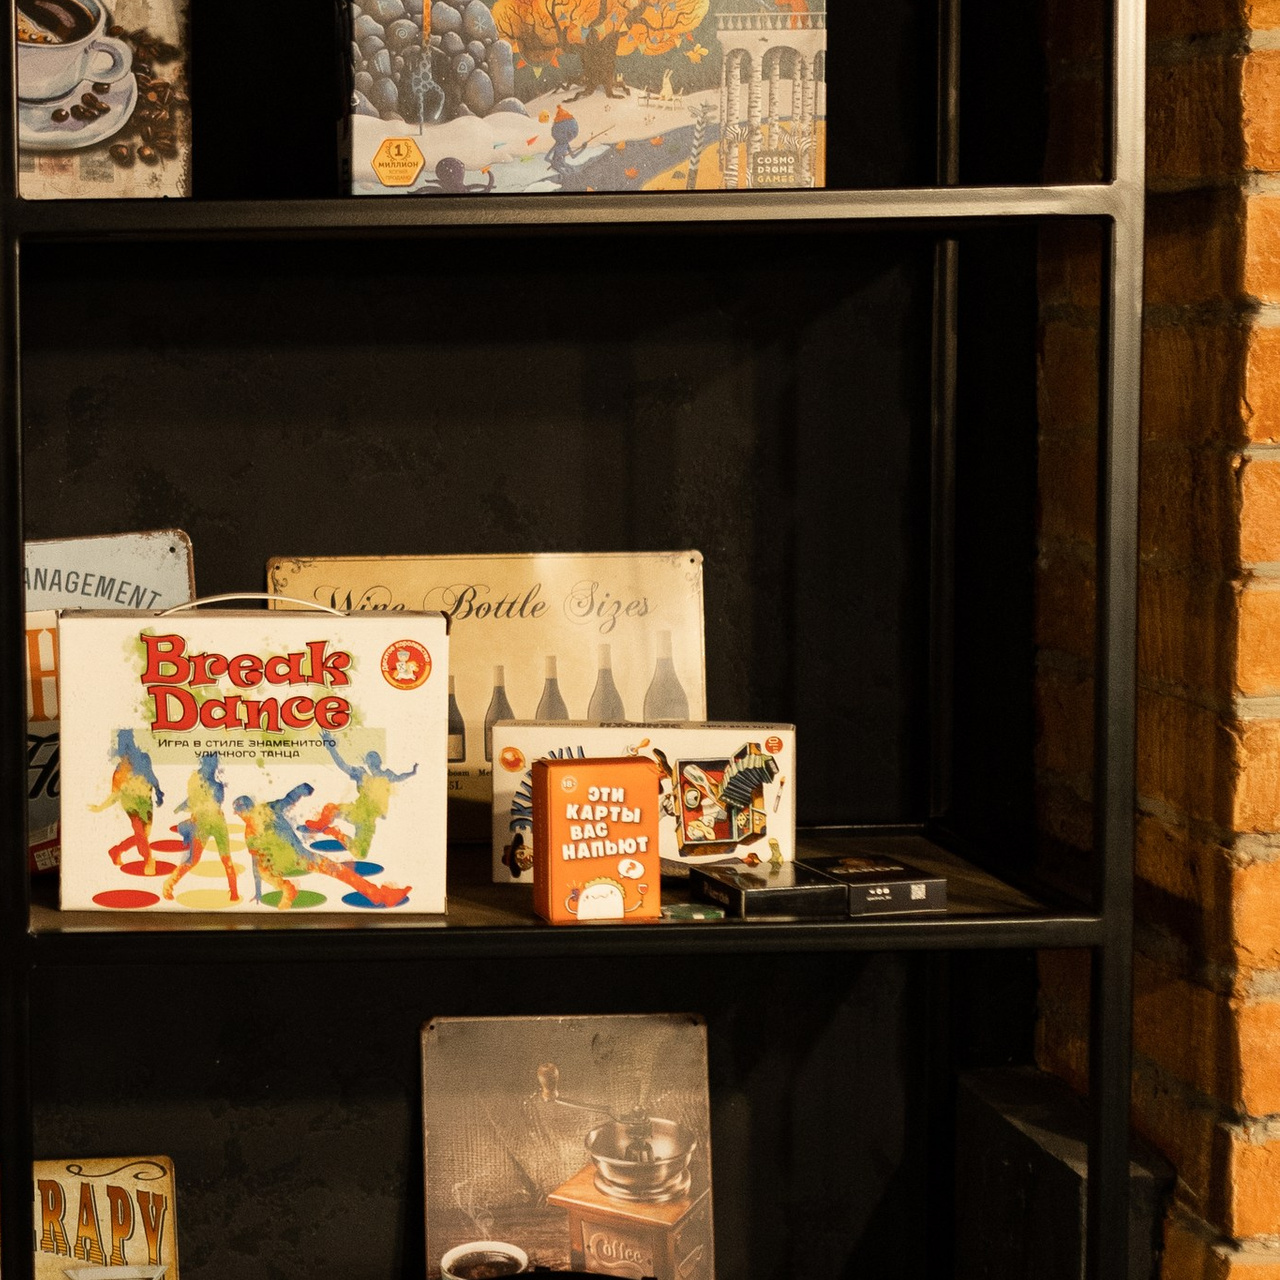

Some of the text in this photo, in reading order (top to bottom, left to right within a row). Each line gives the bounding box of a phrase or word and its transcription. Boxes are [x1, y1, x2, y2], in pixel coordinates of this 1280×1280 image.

[757, 156, 795, 164] COSMO
[757, 175, 795, 184] GAMES
[24, 567, 163, 610] ANAGEMENT
[423, 583, 550, 620] Bottle
[563, 580, 659, 635] Sizes
[140, 632, 352, 689] Break
[148, 685, 352, 734] Dance
[587, 786, 625, 803] ЭТИ
[565, 803, 642, 824] КАРТЫ
[570, 822, 609, 841] ВАС
[562, 835, 649, 861] НАПЬЮТ
